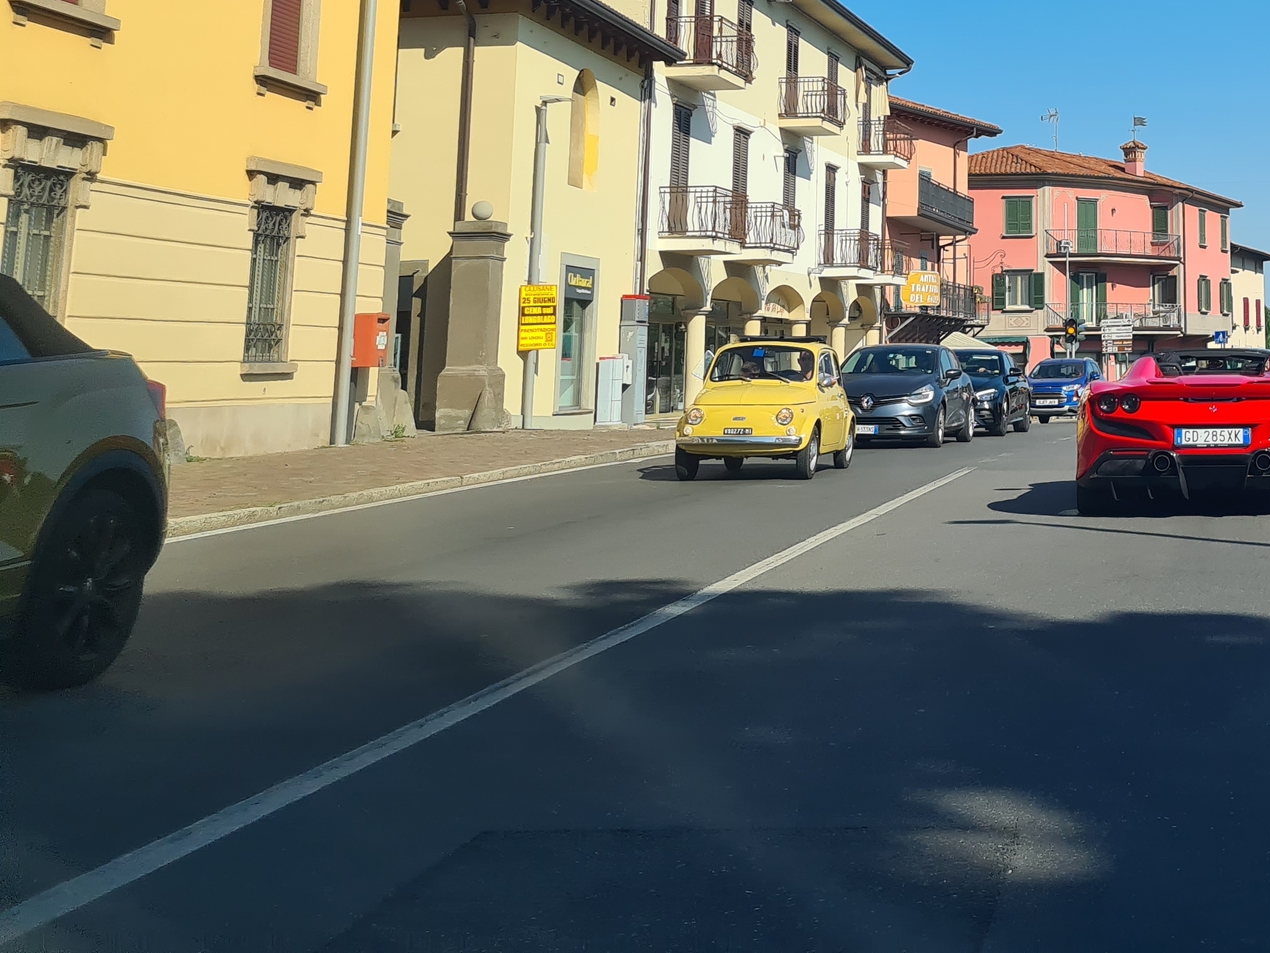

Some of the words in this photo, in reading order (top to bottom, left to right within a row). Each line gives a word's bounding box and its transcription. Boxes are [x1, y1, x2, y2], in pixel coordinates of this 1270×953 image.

[532, 296, 556, 304] GIUGNO
[1184, 430, 1199, 443] GD
[1203, 430, 1241, 443] 285XK
